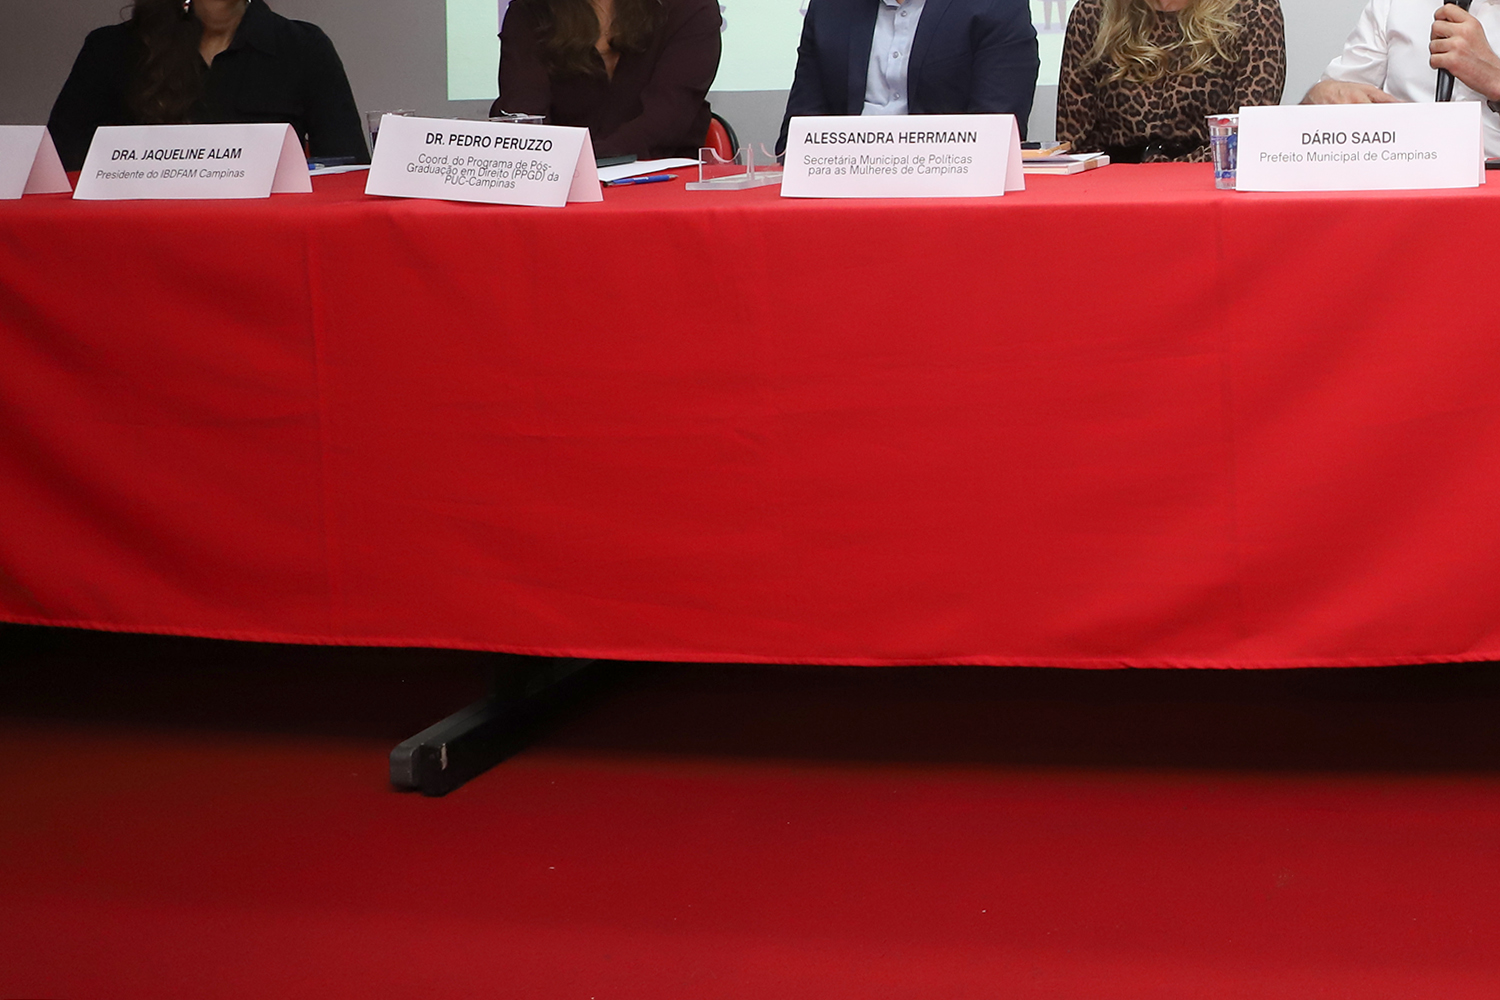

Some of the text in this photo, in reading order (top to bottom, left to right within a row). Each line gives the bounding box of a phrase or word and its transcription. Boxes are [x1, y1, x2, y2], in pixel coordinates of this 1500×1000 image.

[425, 132, 553, 152] DR. PEDRO PERUZZO
[803, 131, 978, 145] ALESSANDRA HERRMANN
[1301, 129, 1396, 145] DÁRIO SAADI
[111, 148, 242, 161] DRA. JAQUELINE ALAM
[803, 153, 973, 167] Secretária Municipal de Políticas
[1259, 150, 1438, 164] Prefeito Municipal de Campinas
[418, 153, 552, 171] Coord. do Programa de Pós-
[95, 168, 245, 179] Presidente do IBDFAM Campinas
[406, 162, 560, 182] Graduação em Direito (PPGD) da
[808, 164, 969, 177] para as Mulheres de Campinas
[444, 175, 515, 189] PUC-Campinas
